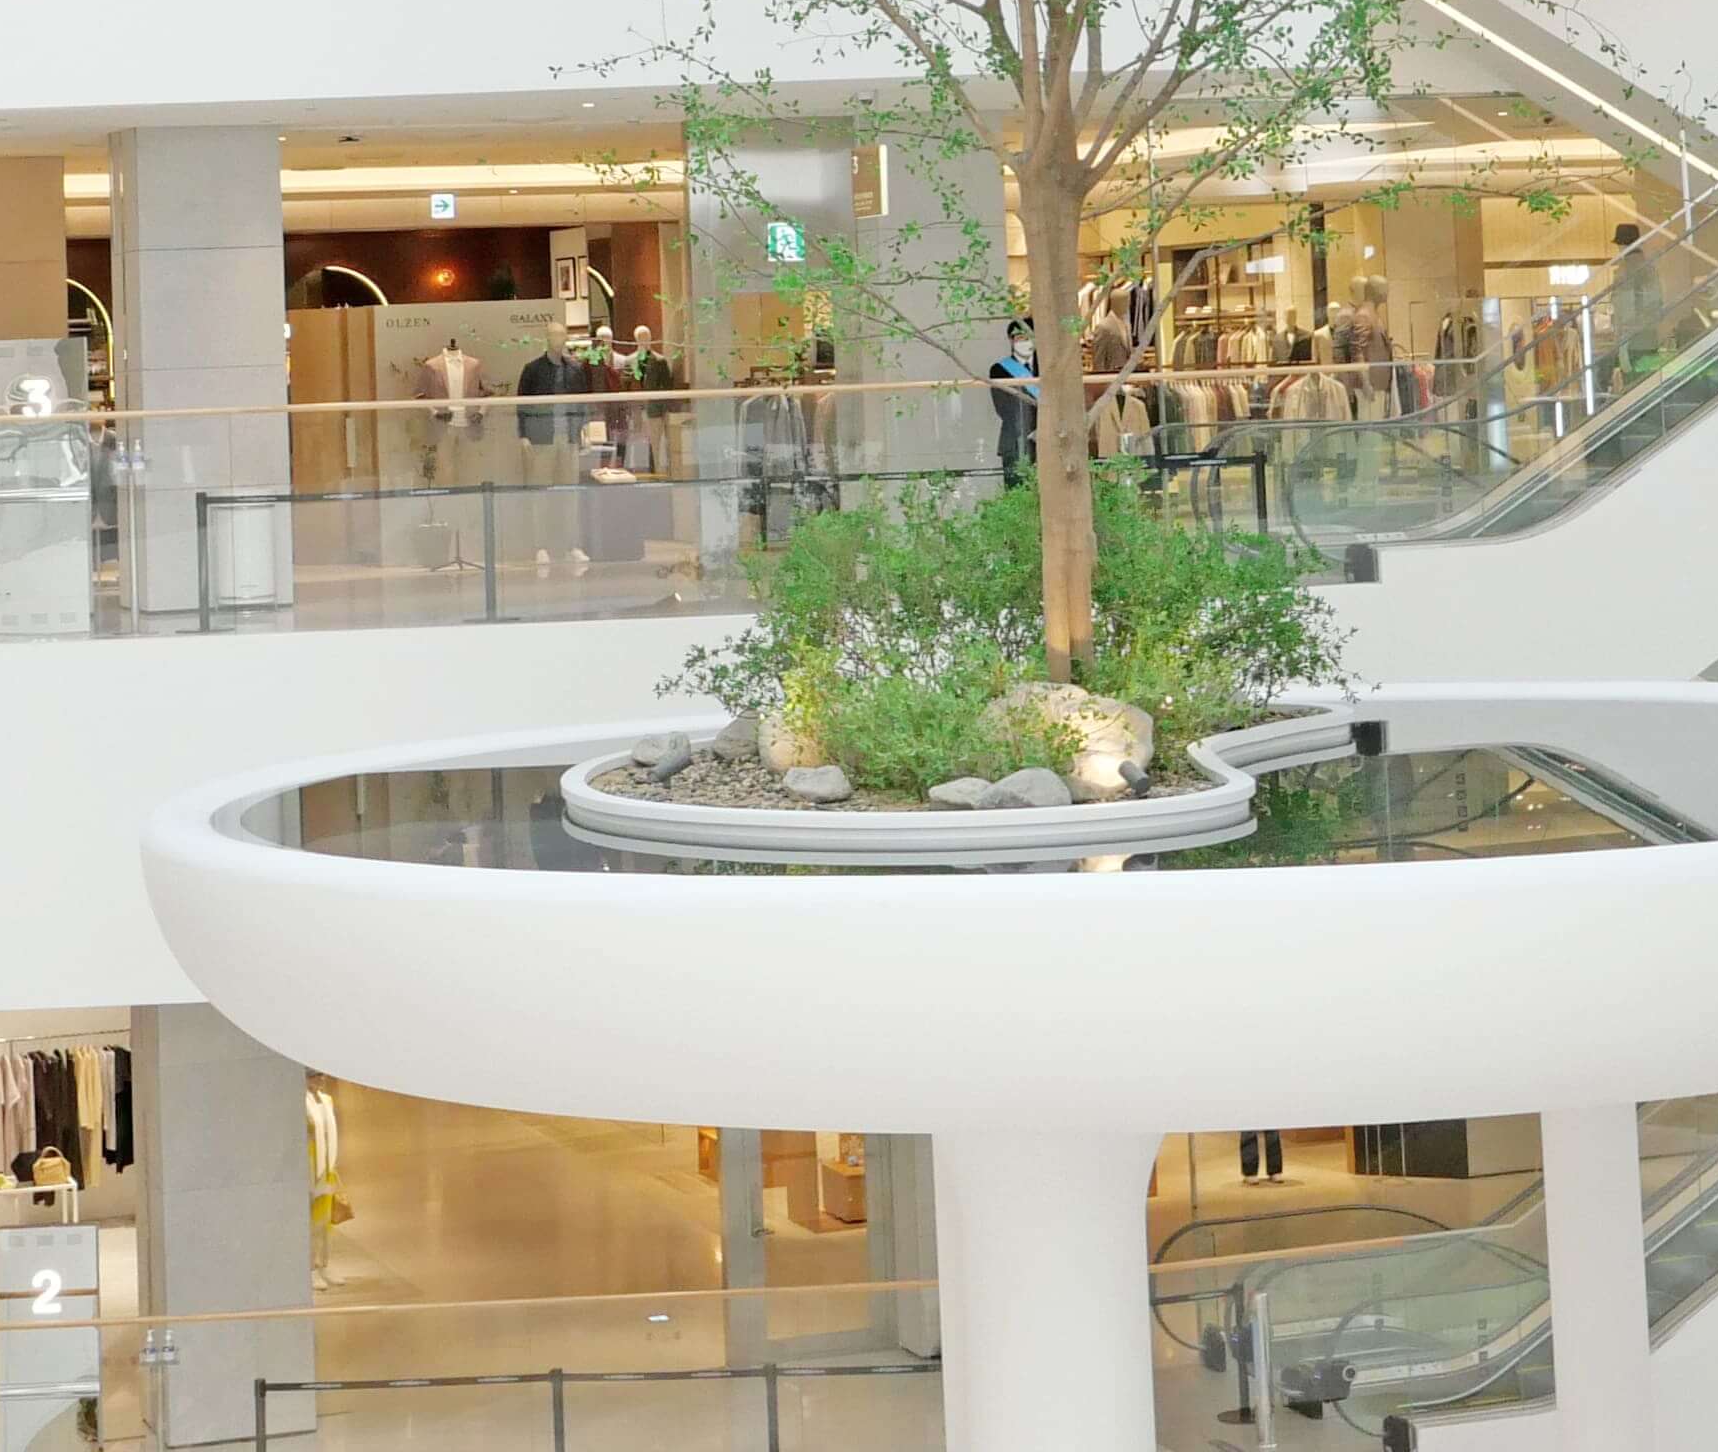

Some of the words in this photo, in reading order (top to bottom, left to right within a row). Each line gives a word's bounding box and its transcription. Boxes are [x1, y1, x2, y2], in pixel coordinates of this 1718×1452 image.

[510, 313, 555, 324] GALAXY
[20, 379, 52, 417] 3
[31, 1269, 62, 1315] 2
